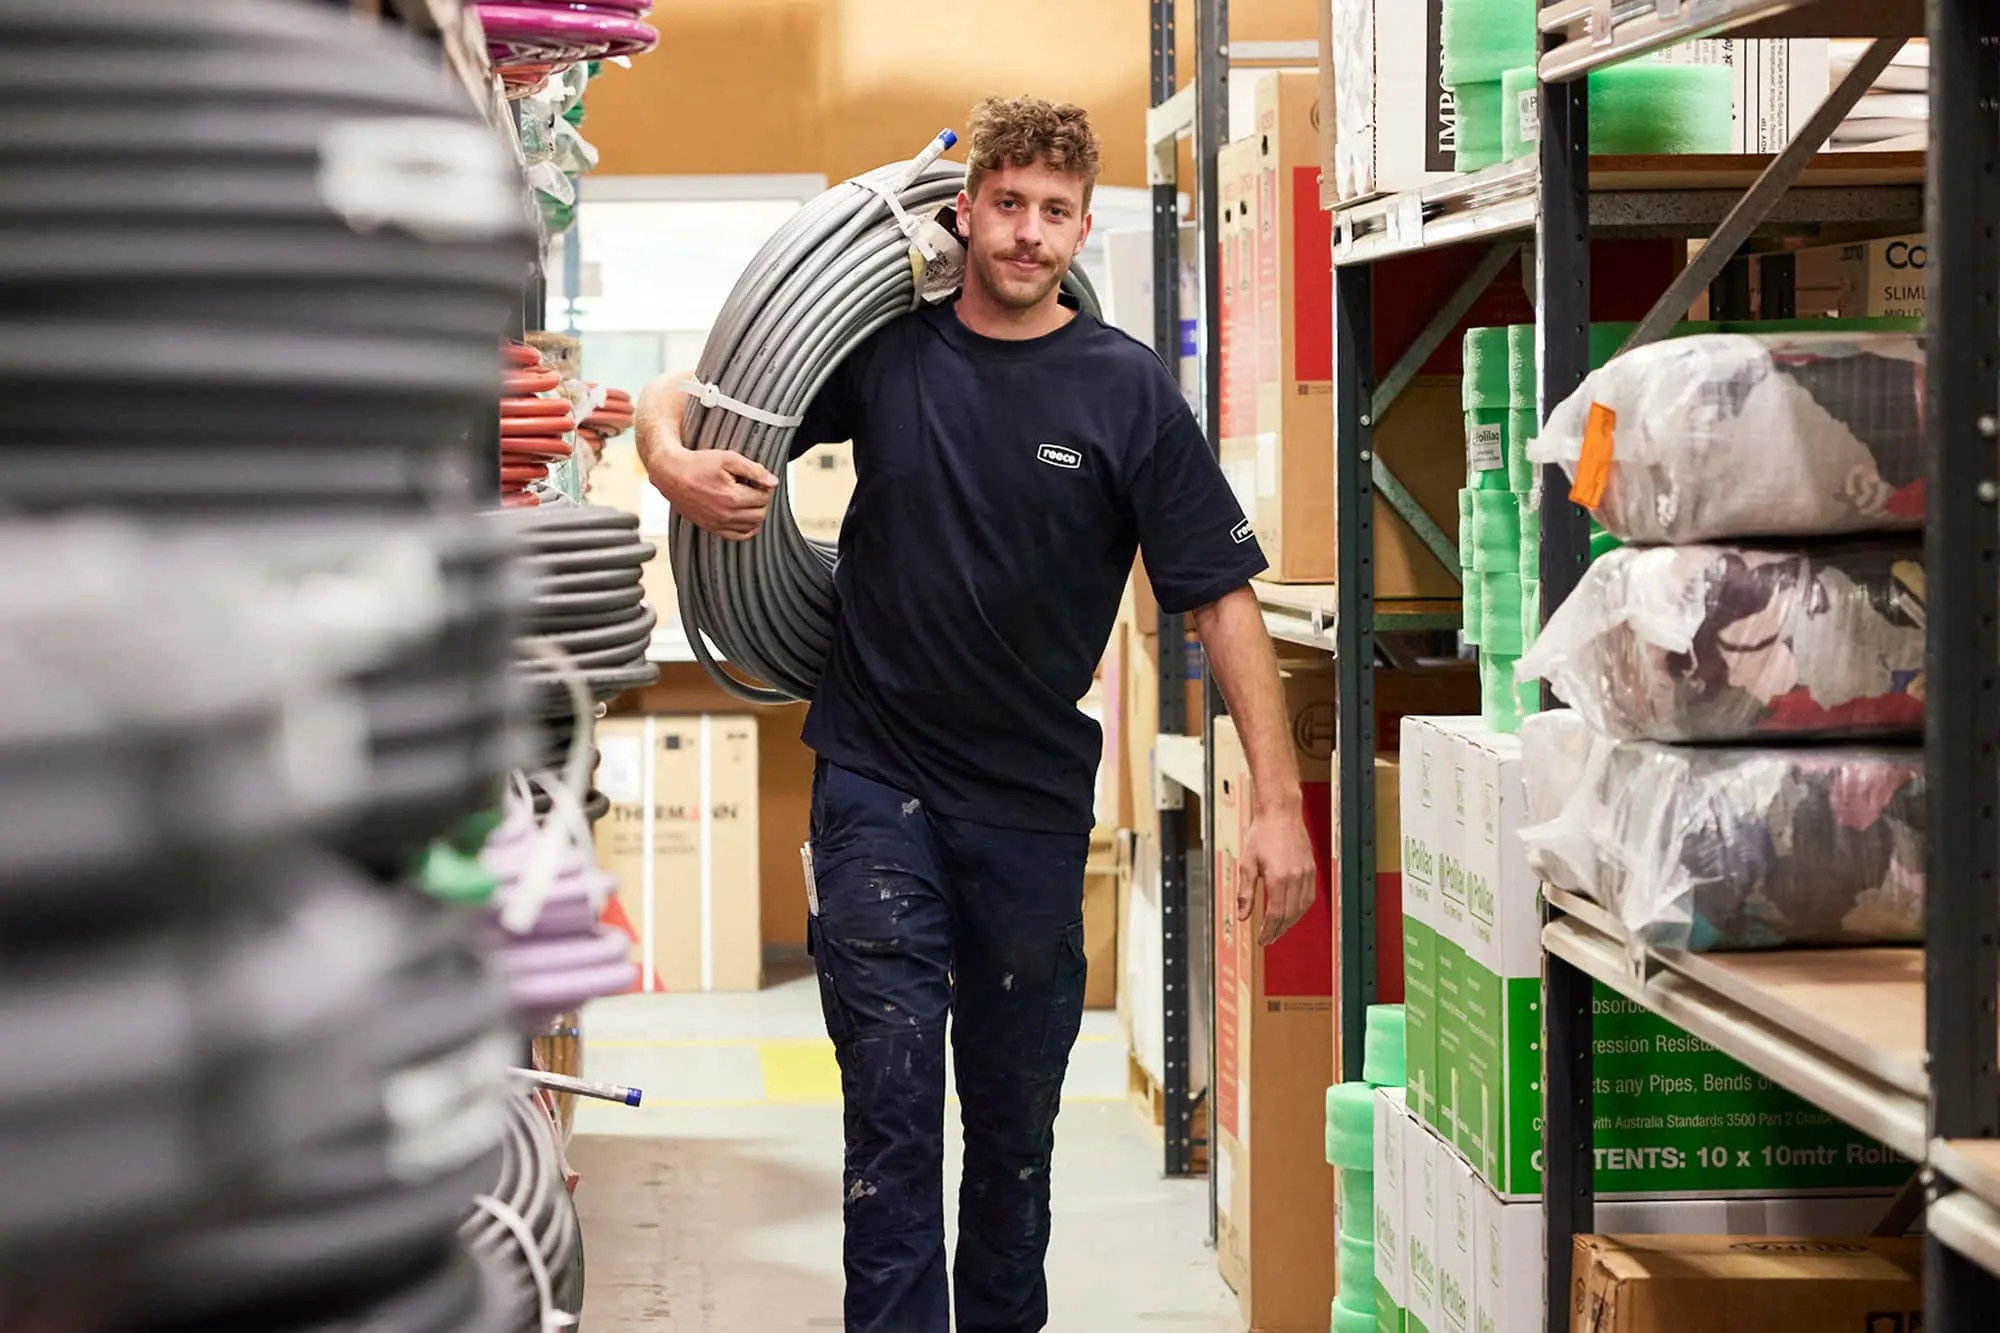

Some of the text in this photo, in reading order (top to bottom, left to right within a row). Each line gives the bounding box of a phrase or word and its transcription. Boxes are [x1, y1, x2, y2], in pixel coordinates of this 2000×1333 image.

[1615, 1078, 1644, 1097] any
[1650, 1074, 1697, 1096] Pipes,
[1704, 1072, 1753, 1092] Bends
[1615, 1115, 1663, 1130] Australia
[1666, 1113, 1723, 1129] Standards
[1727, 1113, 1756, 1127] 3500
[1697, 1146, 1728, 1168] 10
[1736, 1150, 1751, 1168] x
[1761, 1145, 1838, 1167] 10mtr
